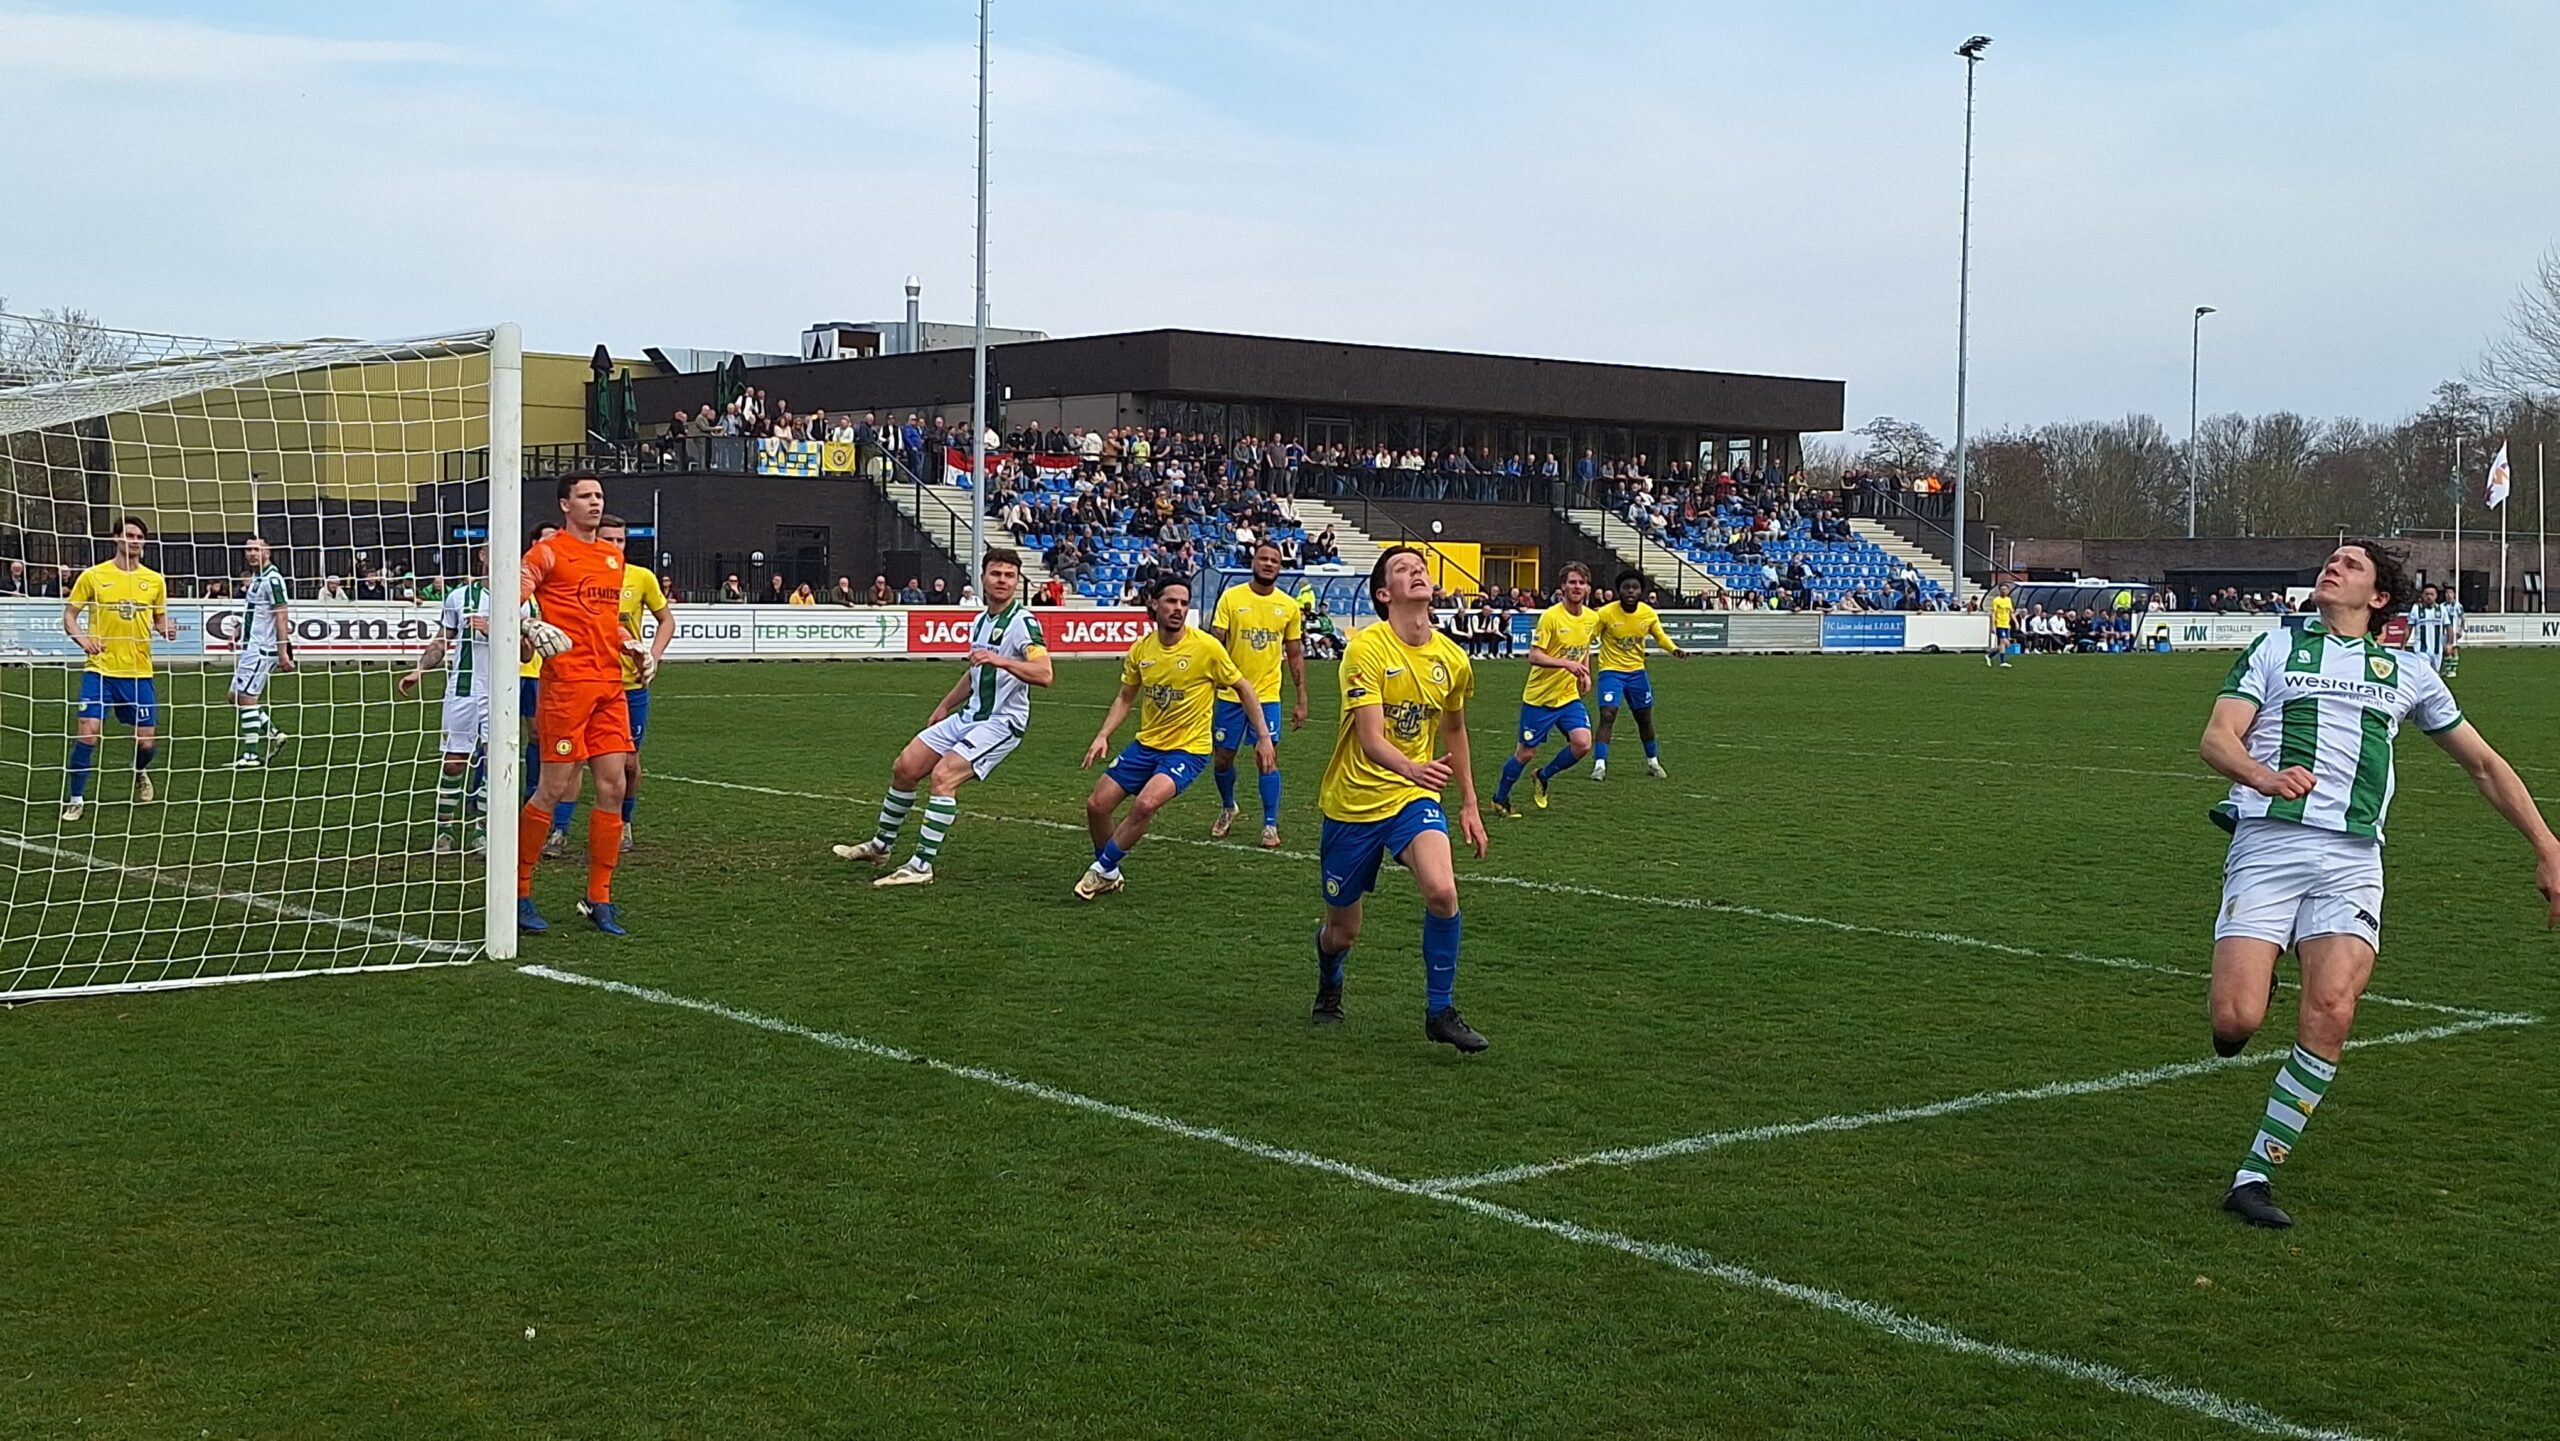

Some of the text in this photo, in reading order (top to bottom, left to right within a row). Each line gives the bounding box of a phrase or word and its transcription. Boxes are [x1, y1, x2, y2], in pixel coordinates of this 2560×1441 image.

[642, 624, 741, 639] GFCLUB
[756, 624, 866, 639] TER SPECKE
[2542, 621, 2560, 637] KV
